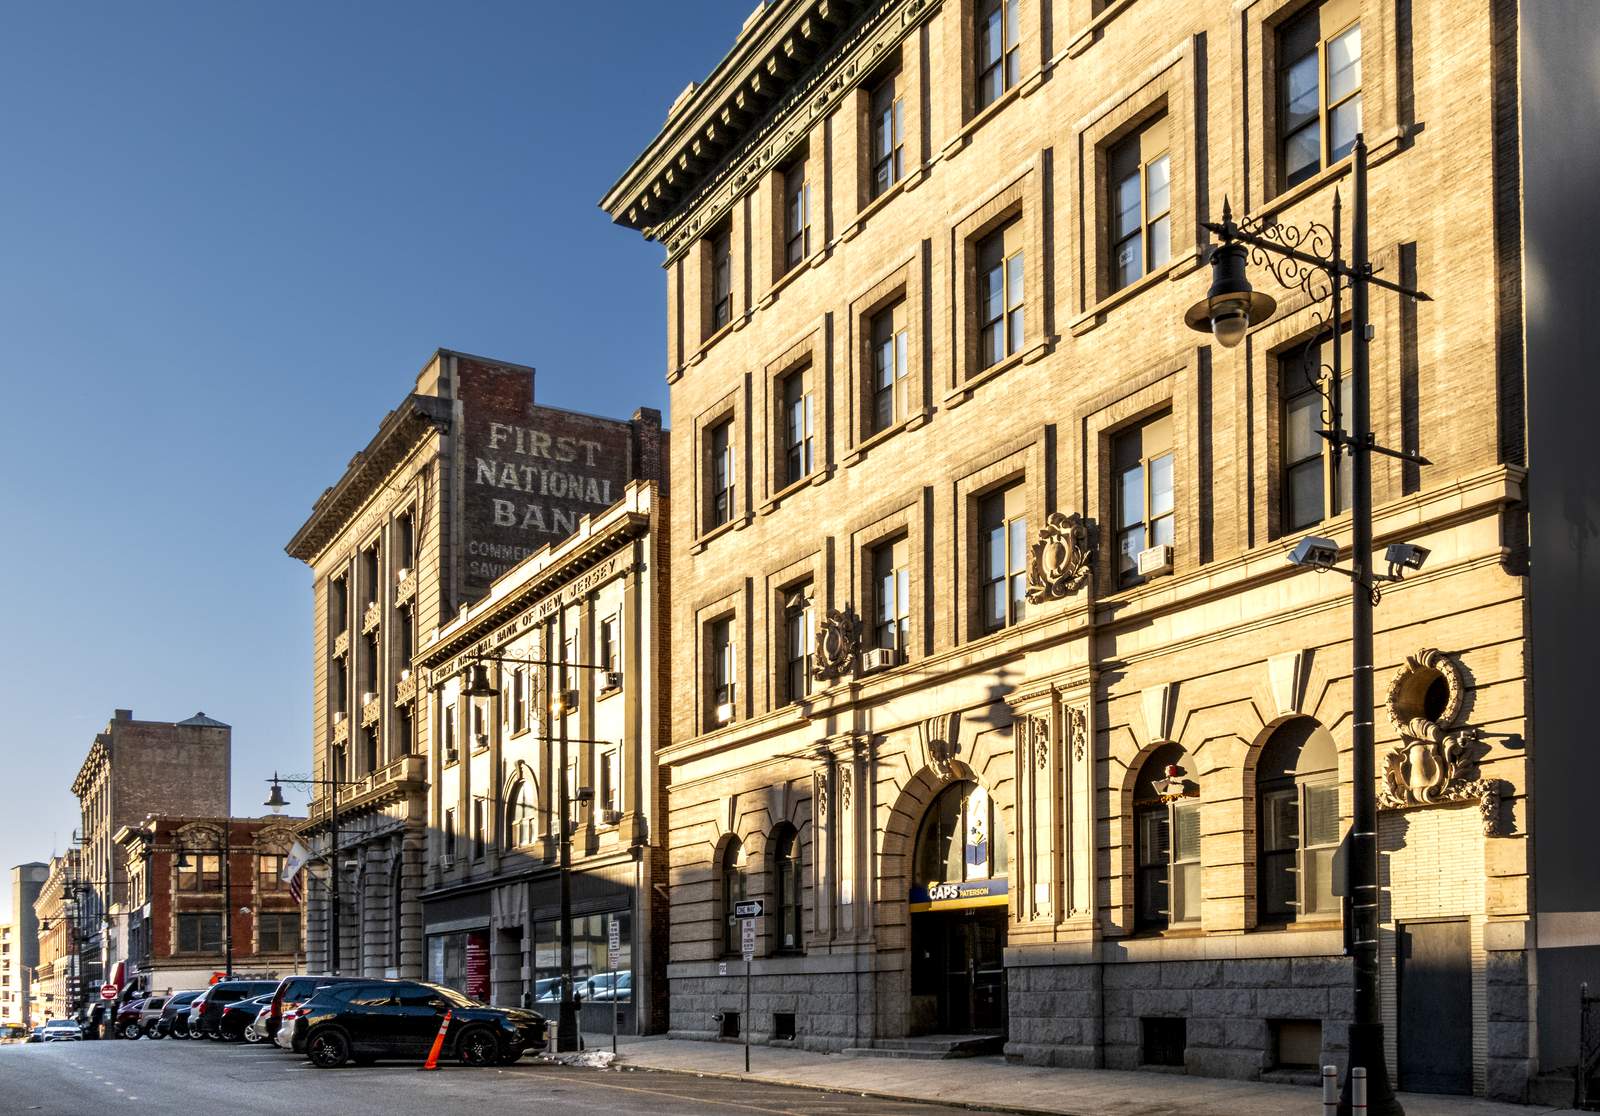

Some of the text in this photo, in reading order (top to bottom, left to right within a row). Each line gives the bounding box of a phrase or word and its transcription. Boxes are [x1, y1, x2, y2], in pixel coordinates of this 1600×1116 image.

[488, 422, 602, 467] FIRST
[475, 457, 614, 505] NATIONAL
[493, 498, 582, 534] BAN
[497, 621, 518, 643] BANK
[522, 611, 535, 627] OF
[539, 593, 563, 617] NEW
[570, 558, 616, 597] JERSEY
[929, 884, 989, 900] CAPS PATERSON
